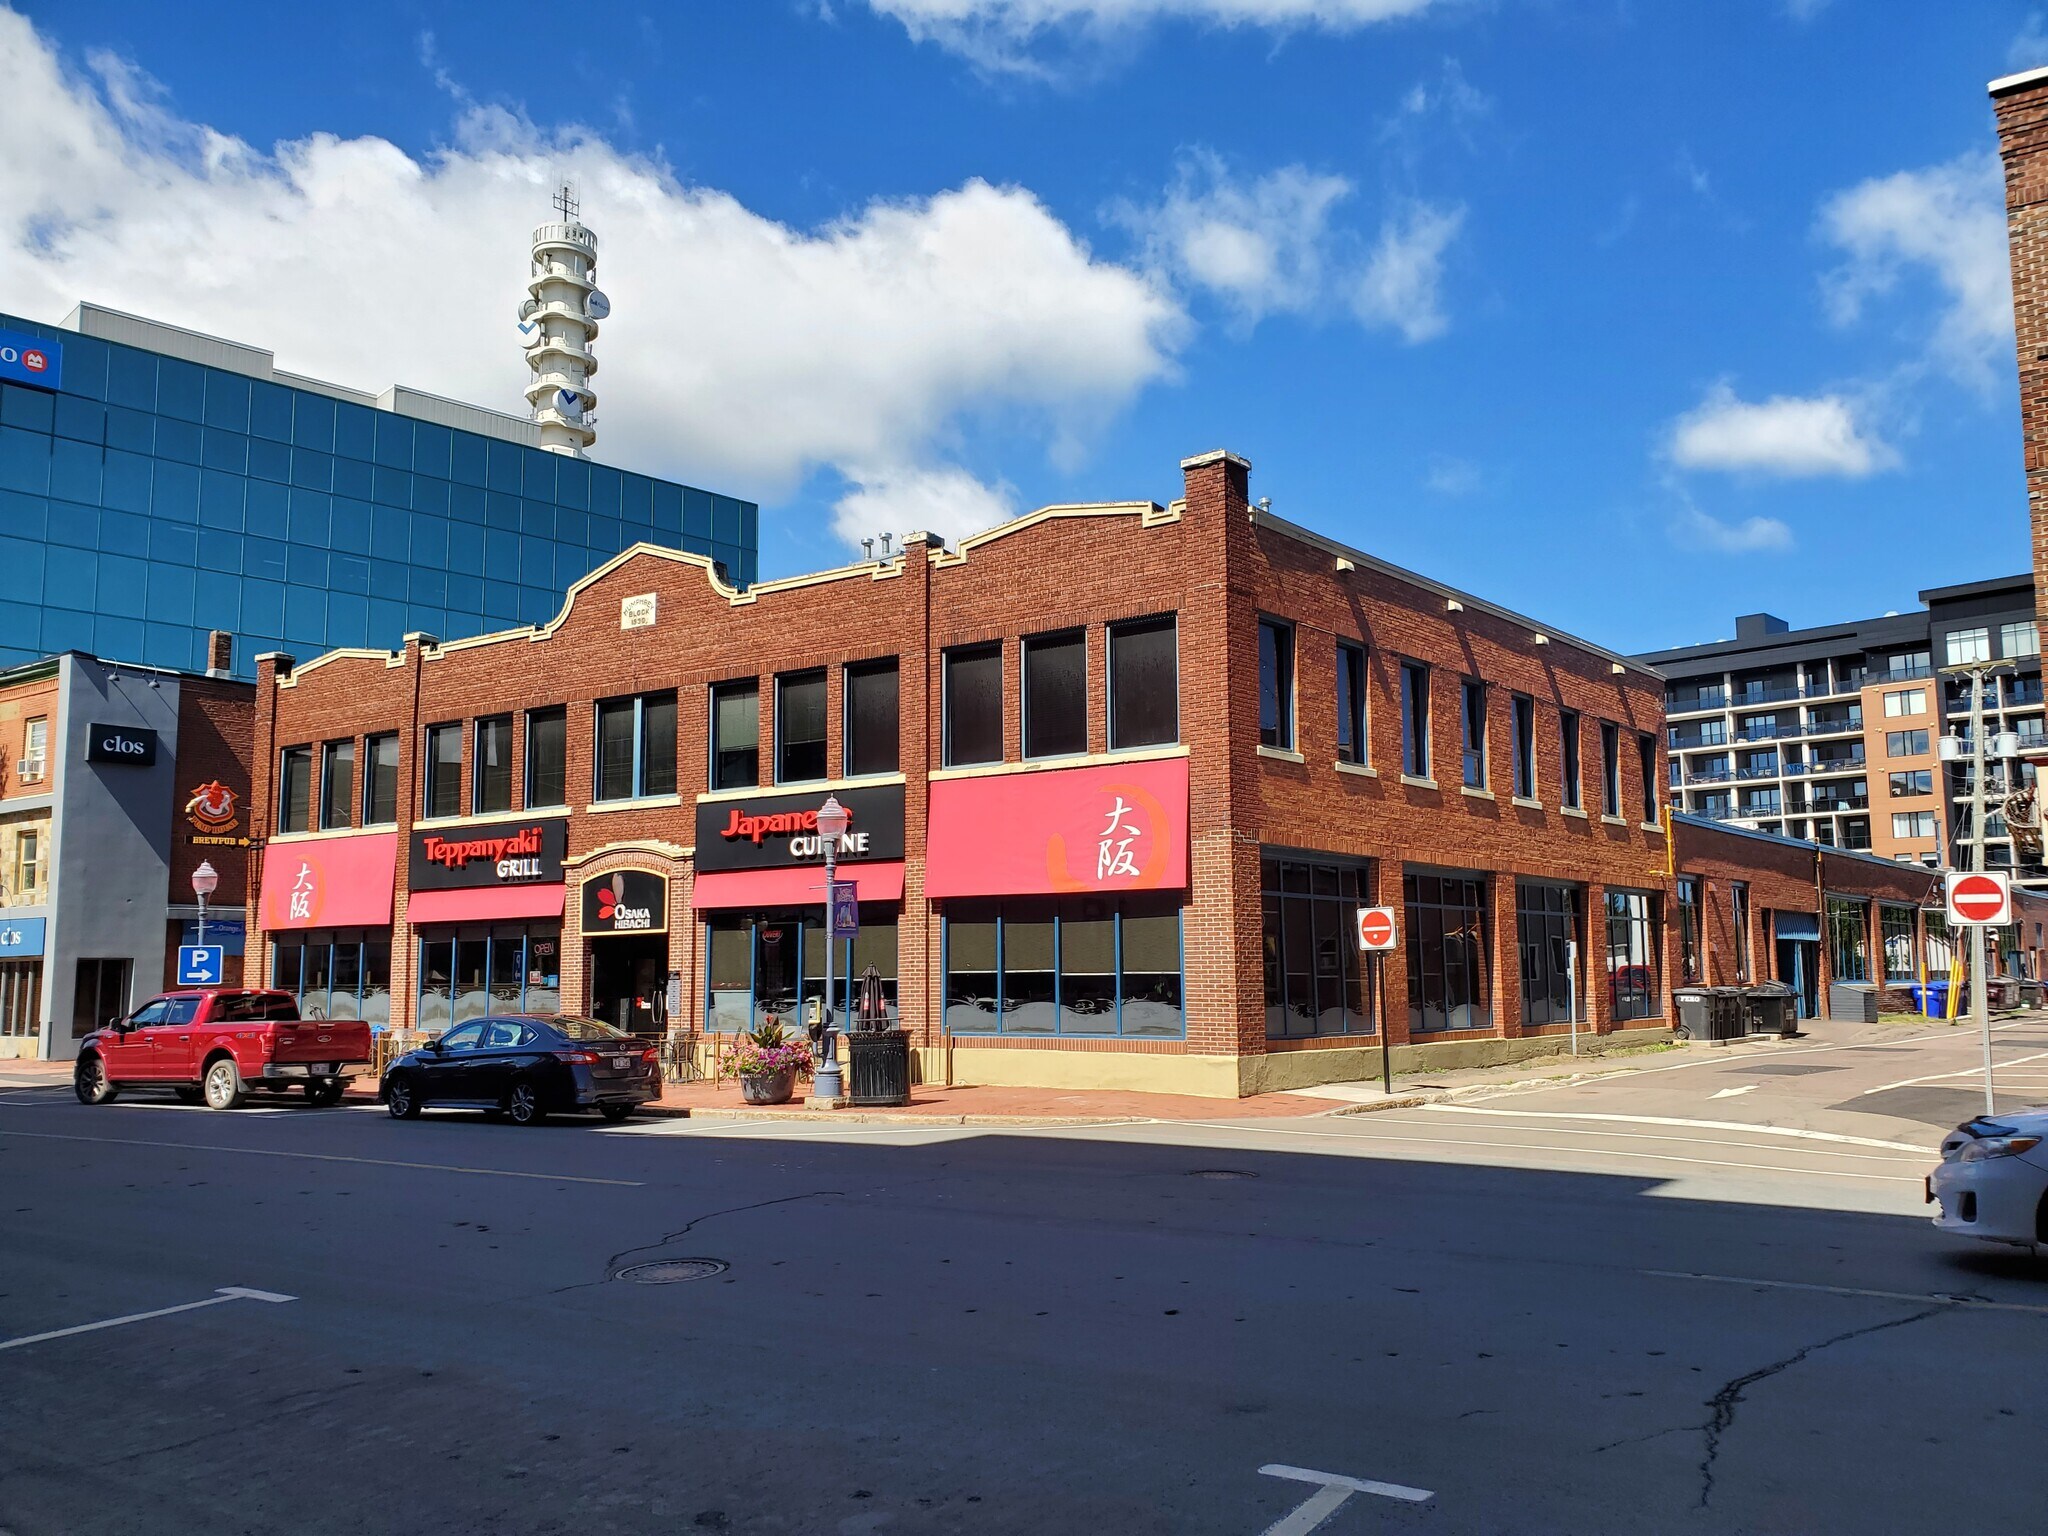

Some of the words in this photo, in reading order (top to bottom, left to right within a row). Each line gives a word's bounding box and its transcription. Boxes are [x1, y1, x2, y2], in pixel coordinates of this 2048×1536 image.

[629, 608, 650, 617] BLOCK
[103, 735, 145, 755] clos
[192, 836, 236, 845] BREWPUB
[423, 825, 543, 868] Teppanyaki
[789, 832, 870, 858] CUINE
[1097, 796, 1142, 880] 大阪
[496, 858, 543, 878] GRILL
[289, 862, 315, 921] 大阪
[614, 919, 651, 930] HIBACHI
[191, 949, 210, 968] P
[534, 942, 555, 955] OPEN
